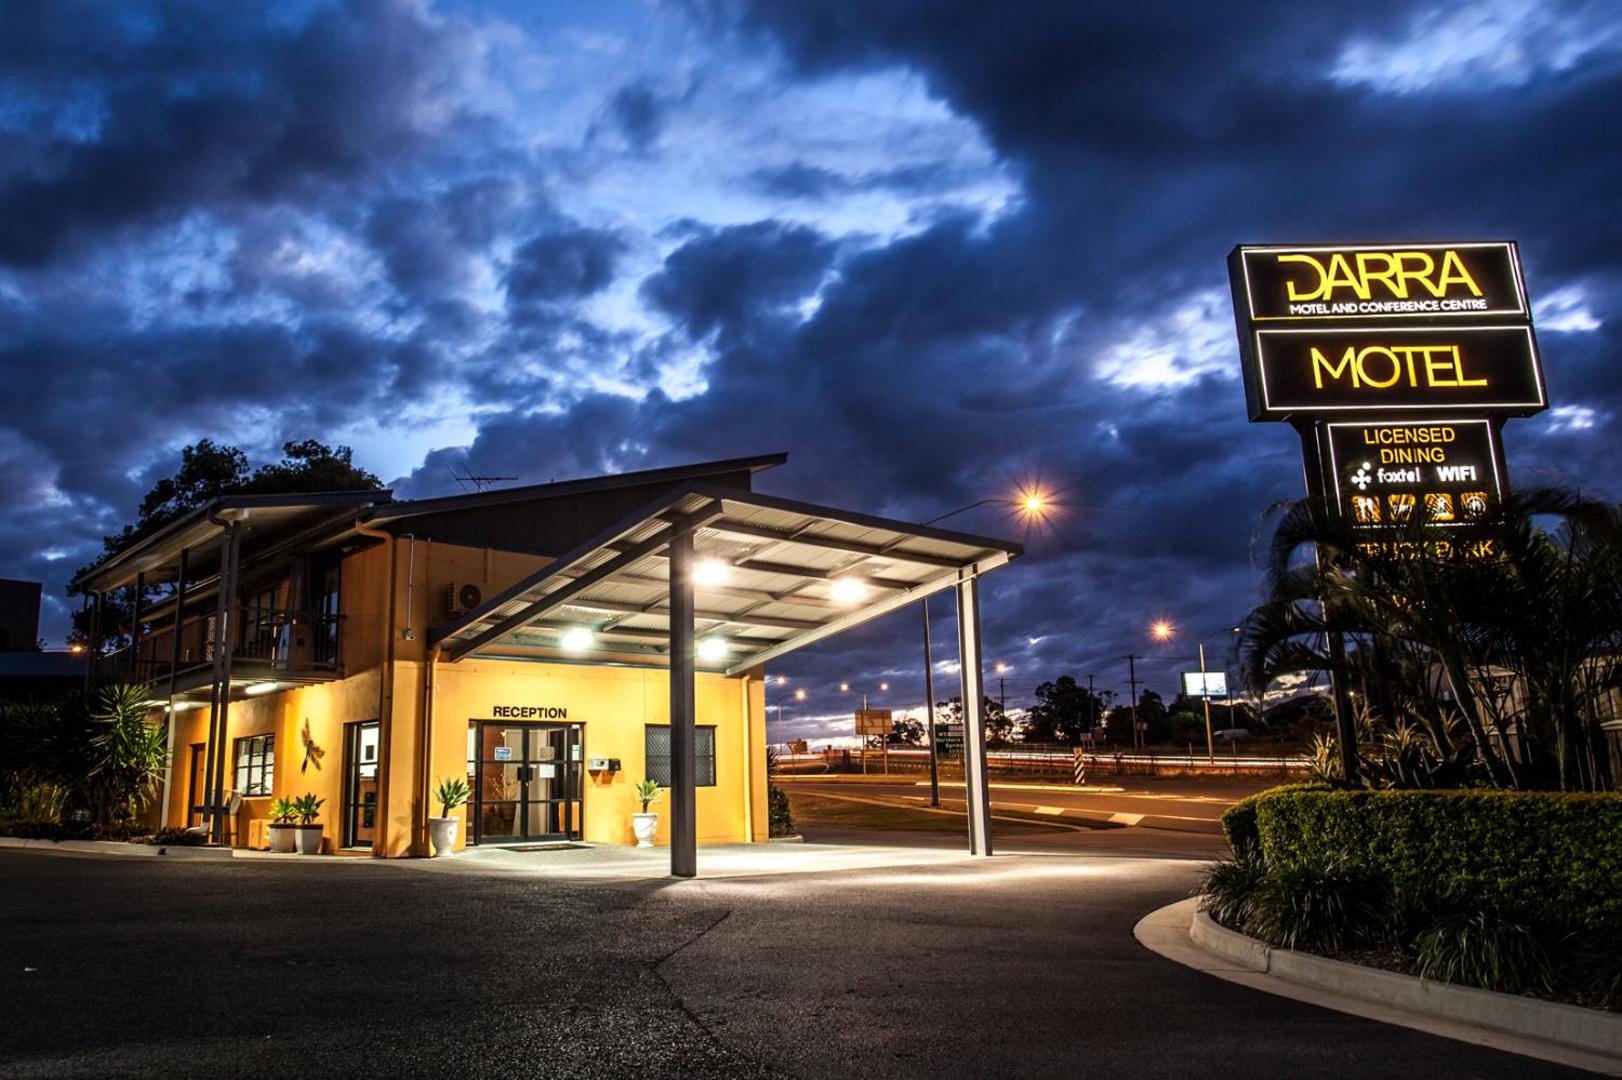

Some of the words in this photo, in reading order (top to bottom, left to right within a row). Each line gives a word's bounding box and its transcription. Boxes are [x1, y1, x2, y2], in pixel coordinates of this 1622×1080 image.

[1277, 250, 1483, 301] DARRA
[1289, 303, 1330, 315] MOTEL
[1331, 302, 1357, 314] AND
[1358, 300, 1440, 313] CONFERENCE
[1440, 299, 1487, 311] CENTRE
[1310, 345, 1488, 389] MOTEL
[1364, 427, 1455, 444] LICENSED
[1381, 447, 1445, 464] DINING
[1377, 467, 1421, 483] foxtel
[1436, 465, 1477, 482] WIFI
[1435, 539, 1494, 559] PK
[493, 706, 567, 718] RECEPTION
